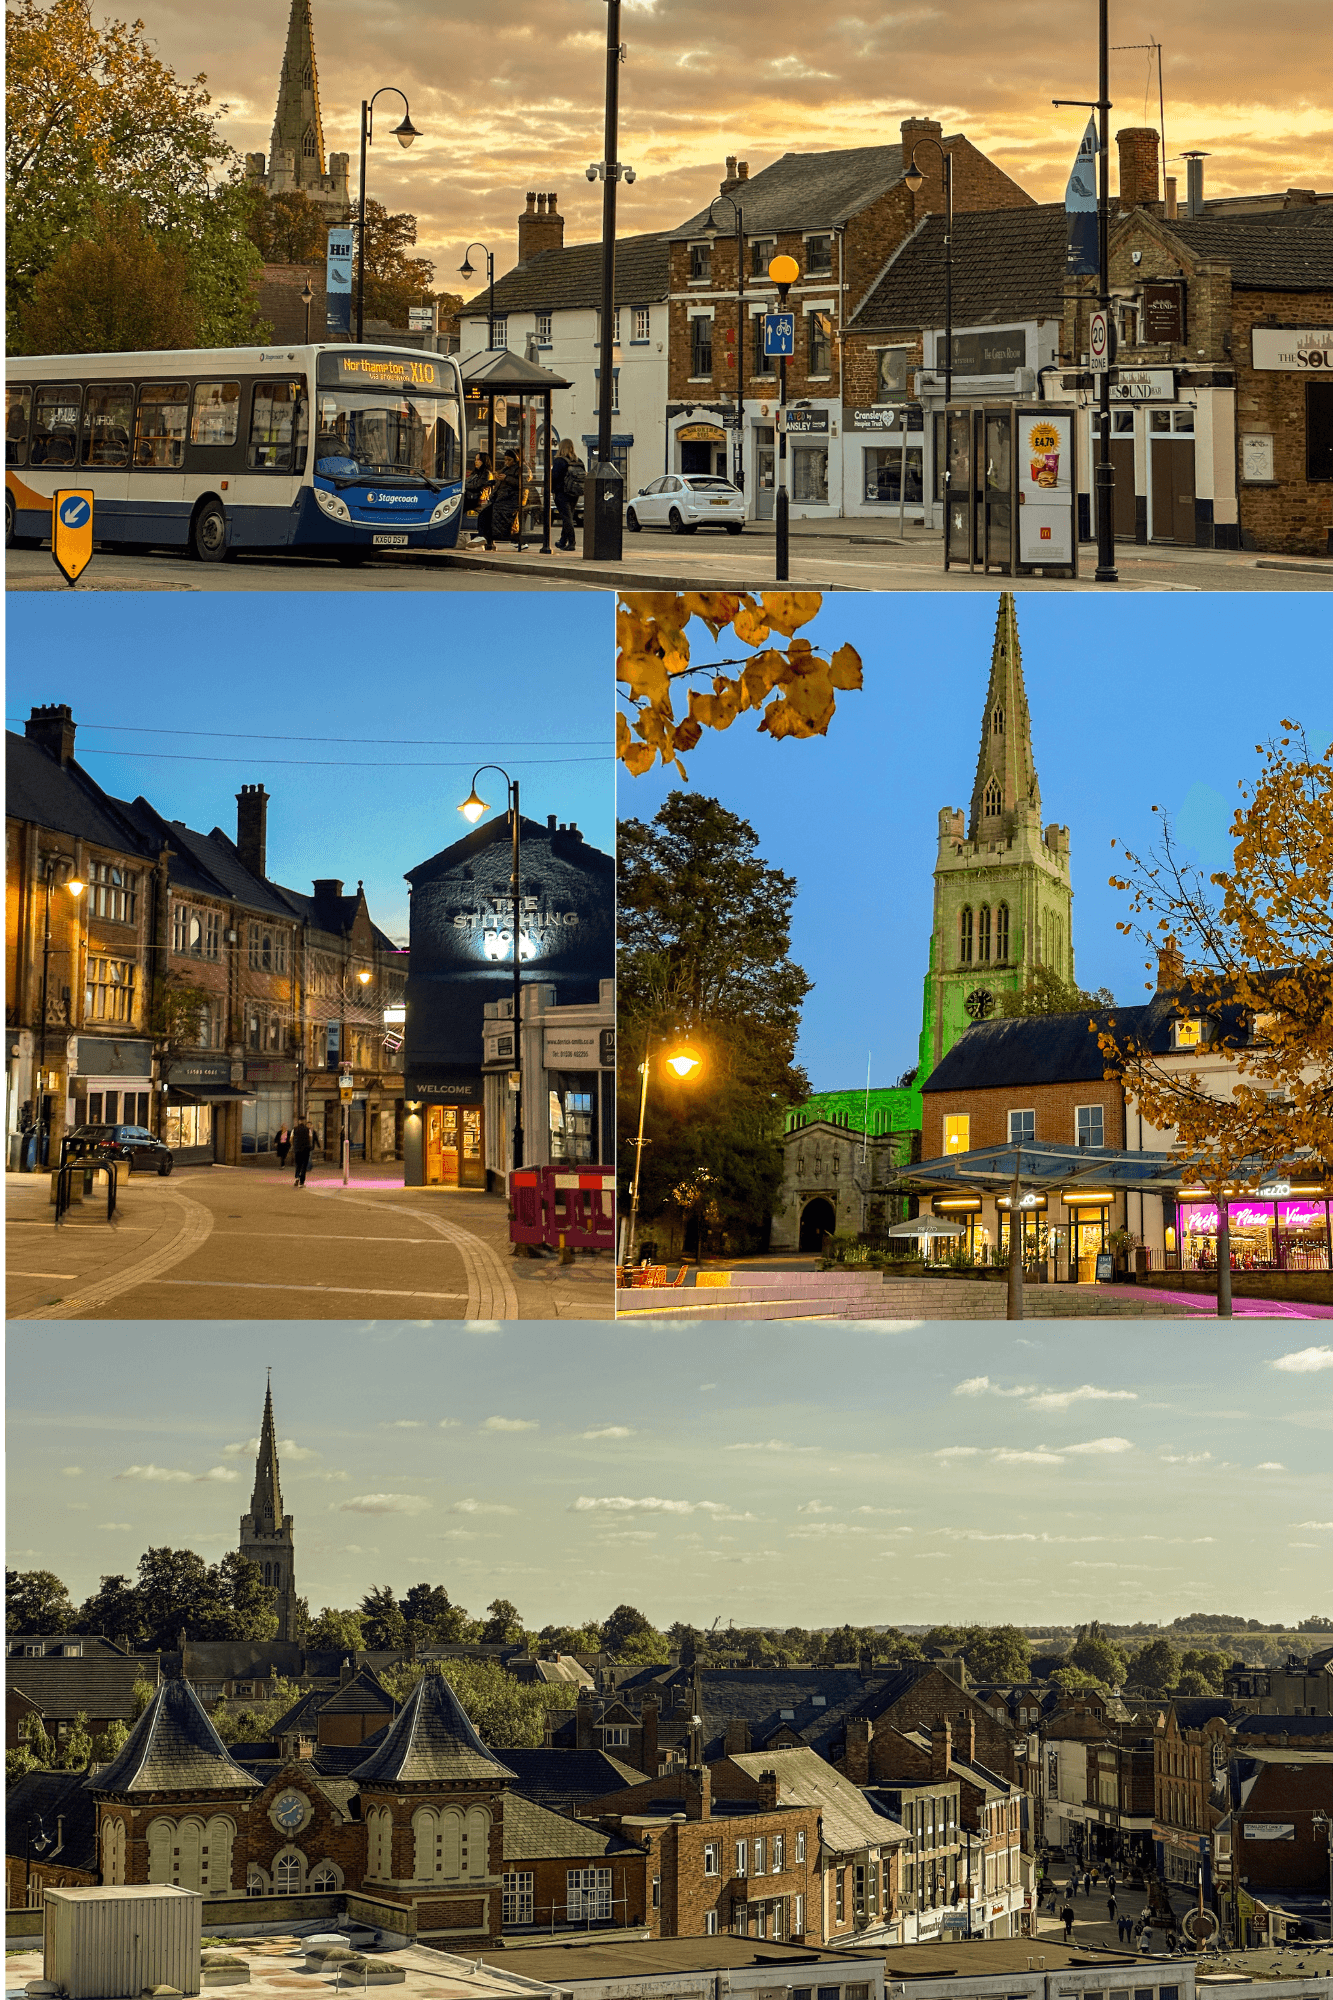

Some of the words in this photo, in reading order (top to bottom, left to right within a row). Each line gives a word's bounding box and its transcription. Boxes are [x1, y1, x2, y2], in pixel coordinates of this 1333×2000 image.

[330, 244, 351, 256] Hi!
[1093, 326, 1104, 344] 20
[1091, 358, 1106, 369] ZONE
[1278, 353, 1297, 363] THE
[343, 357, 405, 374] Northampton
[410, 361, 435, 384] X10
[1116, 384, 1152, 398] SOUND
[478, 407, 488, 419] 17
[854, 410, 883, 421] Cransley
[378, 493, 418, 504] Stagecoach
[375, 535, 392, 544] KX60
[392, 536, 405, 544] DSV
[453, 912, 579, 928] STITCHING
[417, 1084, 472, 1095] WELCOME
[1188, 1211, 1218, 1229] Pasta
[1236, 1208, 1269, 1225] Pizza
[1285, 1206, 1319, 1225] Vino
[900, 1895, 912, 1905] W
